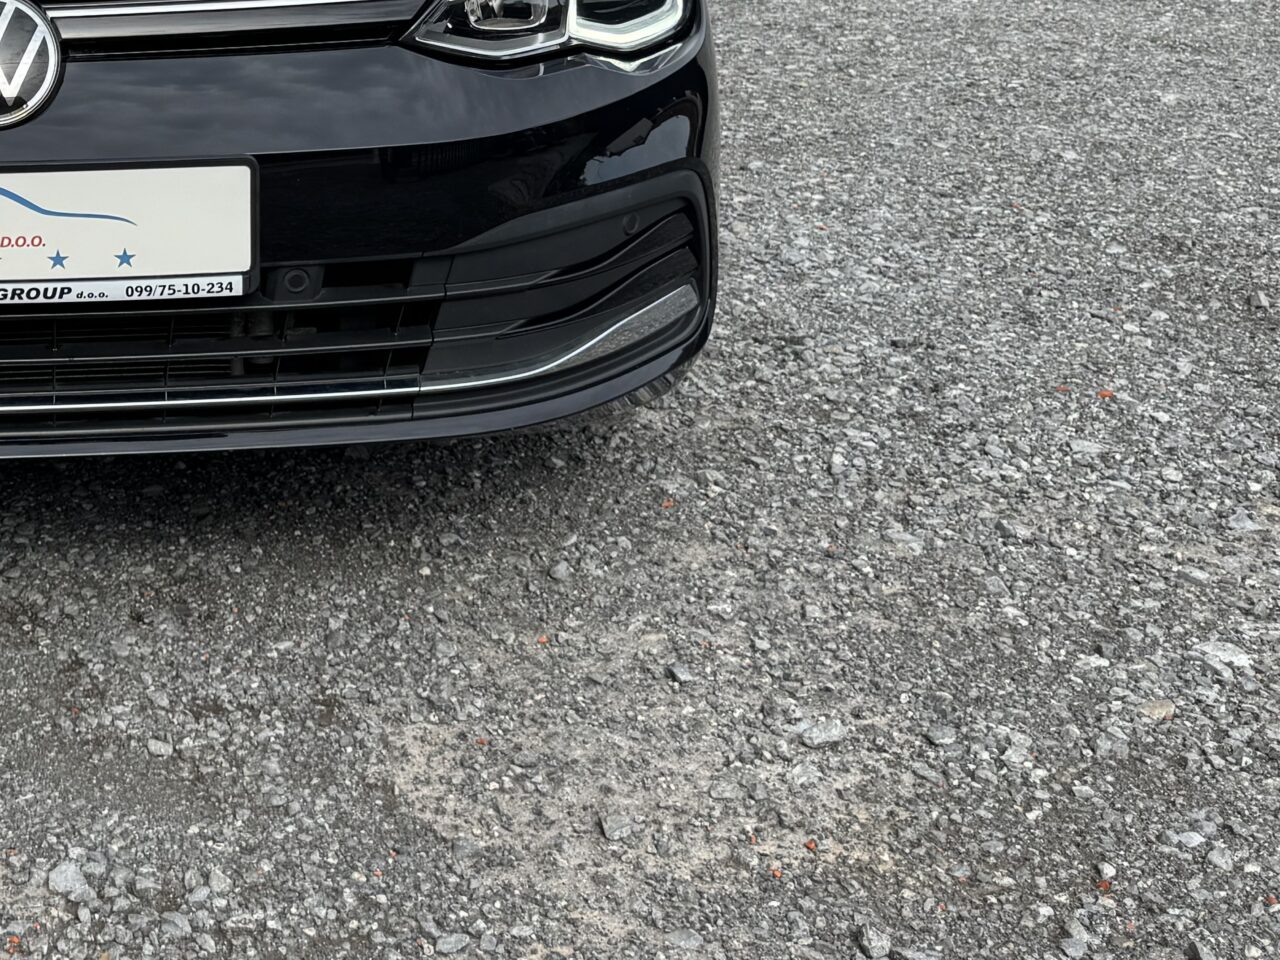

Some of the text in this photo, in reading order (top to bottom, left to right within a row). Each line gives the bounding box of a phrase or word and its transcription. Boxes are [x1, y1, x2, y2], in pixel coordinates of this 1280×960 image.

[0, 236, 46, 248] D.O.O.
[76, 290, 109, 300] d.o.o.
[125, 281, 234, 298] 099/75-10-234
